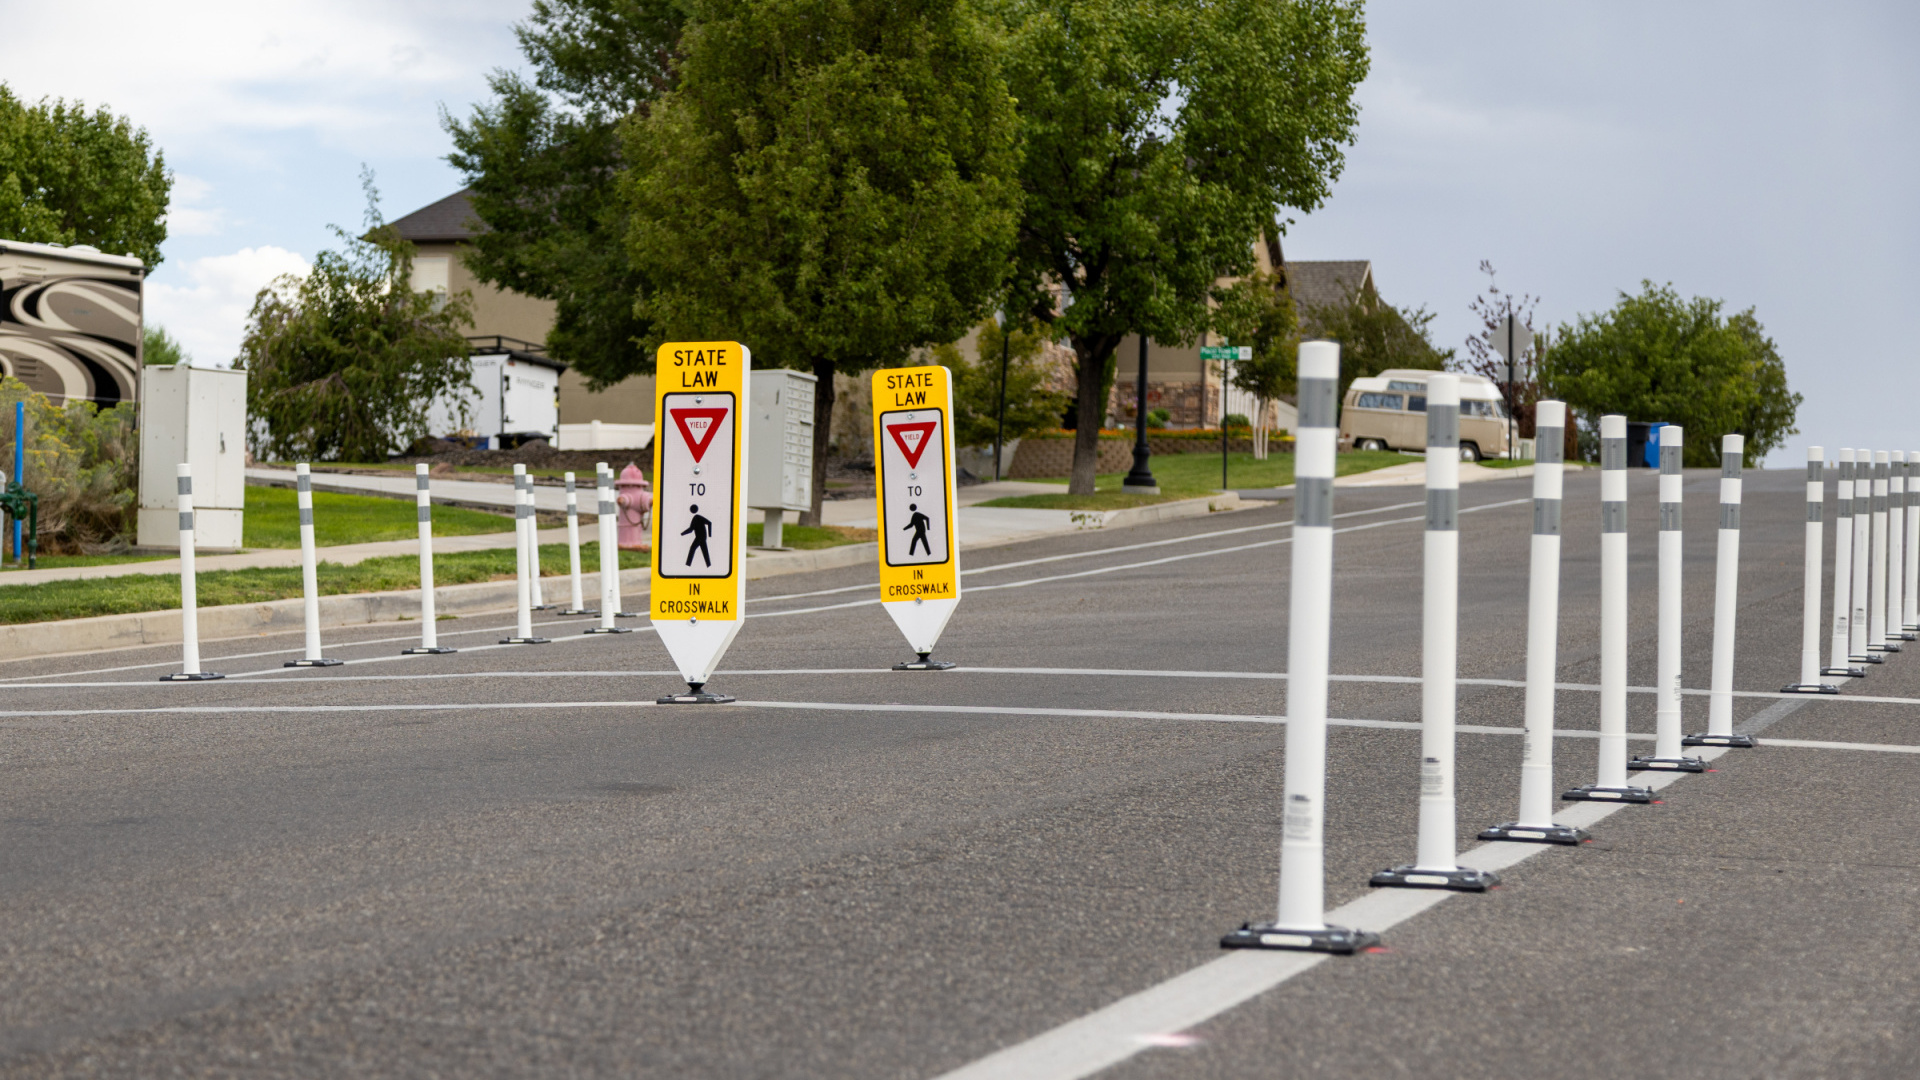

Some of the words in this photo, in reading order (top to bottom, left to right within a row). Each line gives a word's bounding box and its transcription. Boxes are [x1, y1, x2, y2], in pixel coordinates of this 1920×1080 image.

[674, 349, 727, 366] STATE
[682, 371, 718, 387] LAW
[887, 373, 933, 389] STATE
[896, 391, 926, 407] LAW
[690, 421, 708, 429] YIELD
[904, 433, 920, 441] YIELD
[689, 483, 706, 496] TO
[907, 485, 922, 497] TO
[913, 569, 924, 580] IN
[689, 583, 700, 595] IN
[888, 582, 949, 596] CROSSWALK
[660, 600, 729, 613] CROSSWALK
